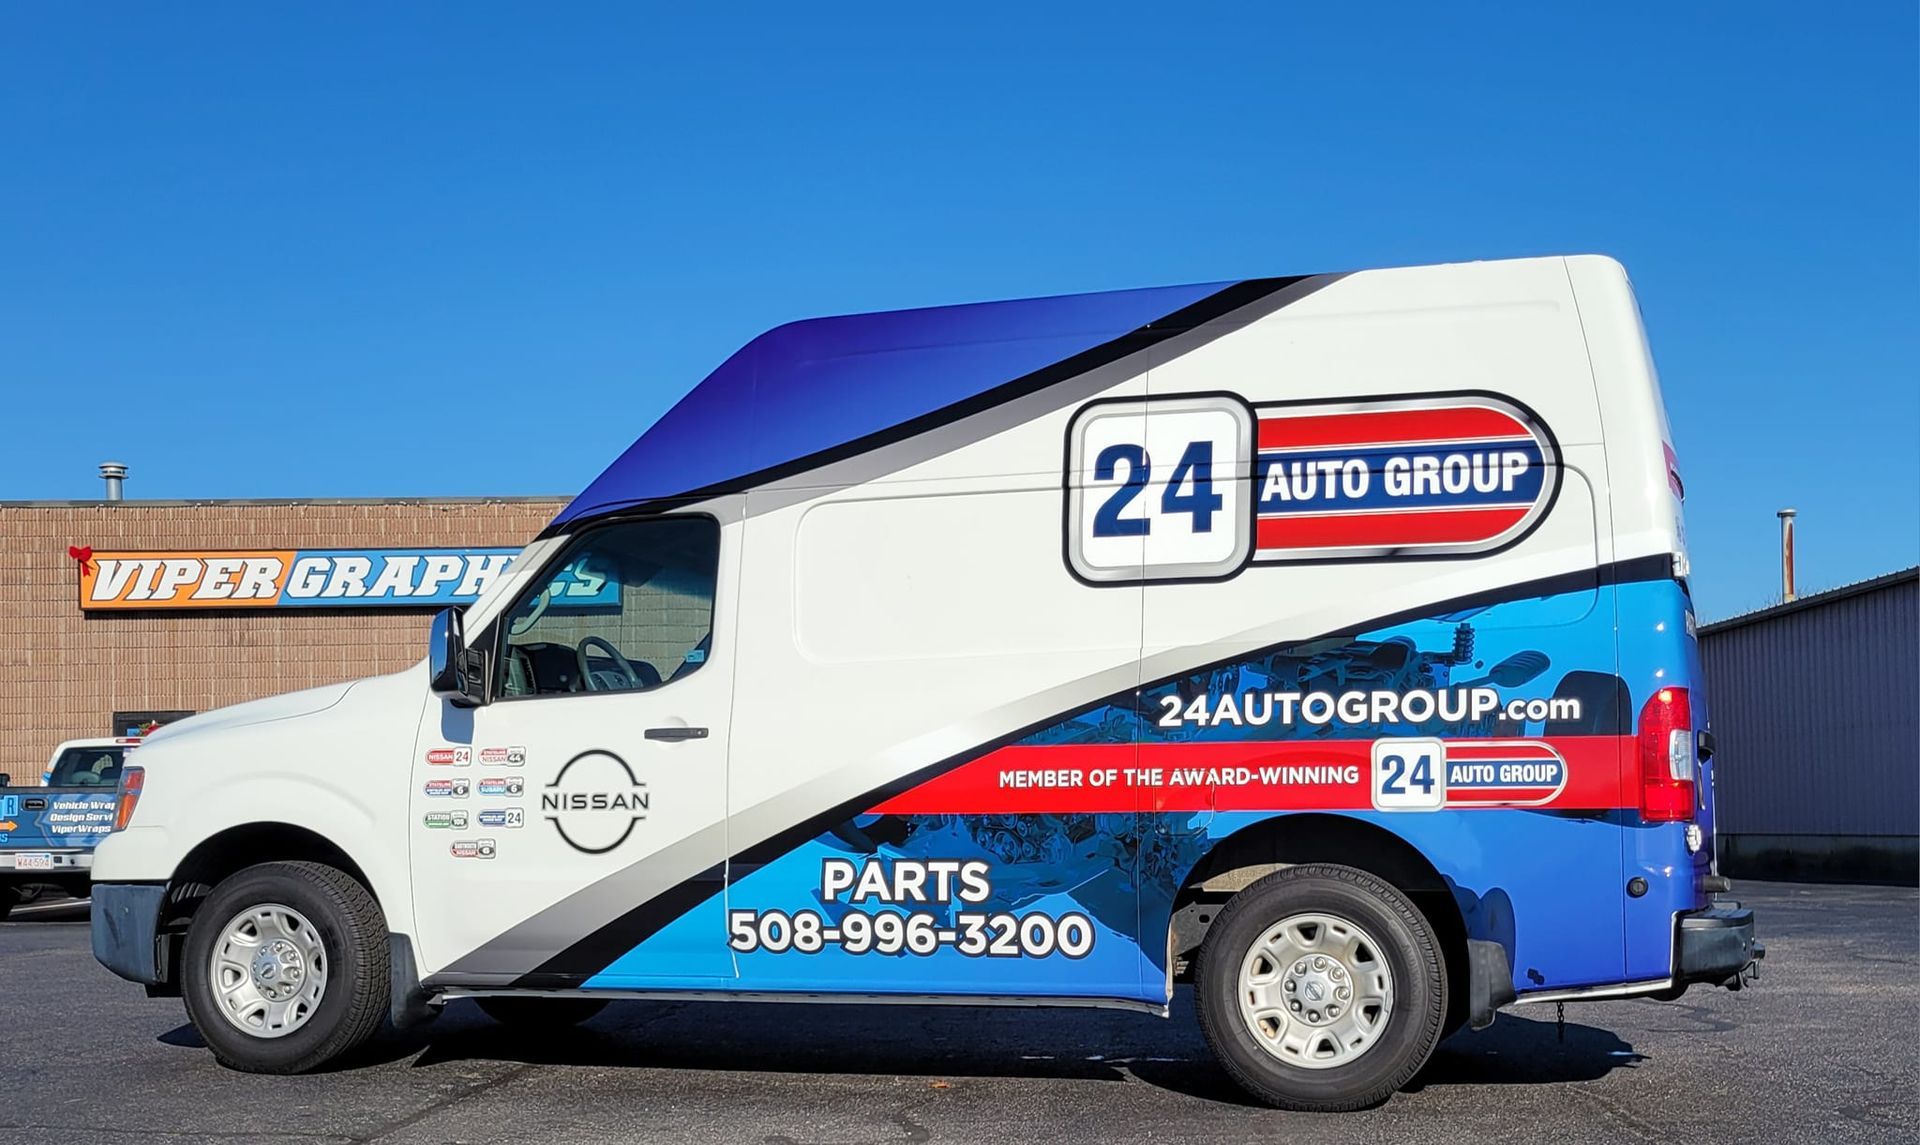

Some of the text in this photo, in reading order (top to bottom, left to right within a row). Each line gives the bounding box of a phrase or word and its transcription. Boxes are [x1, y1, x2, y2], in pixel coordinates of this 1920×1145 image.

[1092, 439, 1529, 537] 24 AUTO GROUP
[90, 553, 607, 601] VIPER GRAPHCS
[1158, 688, 1581, 728] 24AUTOGROUP.com
[456, 751, 469, 762] 24
[999, 765, 1360, 788] MEMBER OF THE AWARD-WINNING
[1381, 754, 1558, 795] 24 AUTO GROUP
[53, 801, 88, 810] Vehicle
[541, 793, 649, 810] NISSAN
[50, 813, 86, 823] Design
[507, 813, 521, 823] 24
[823, 860, 990, 903] PARTS
[730, 912, 1093, 957] 508-996-3200
